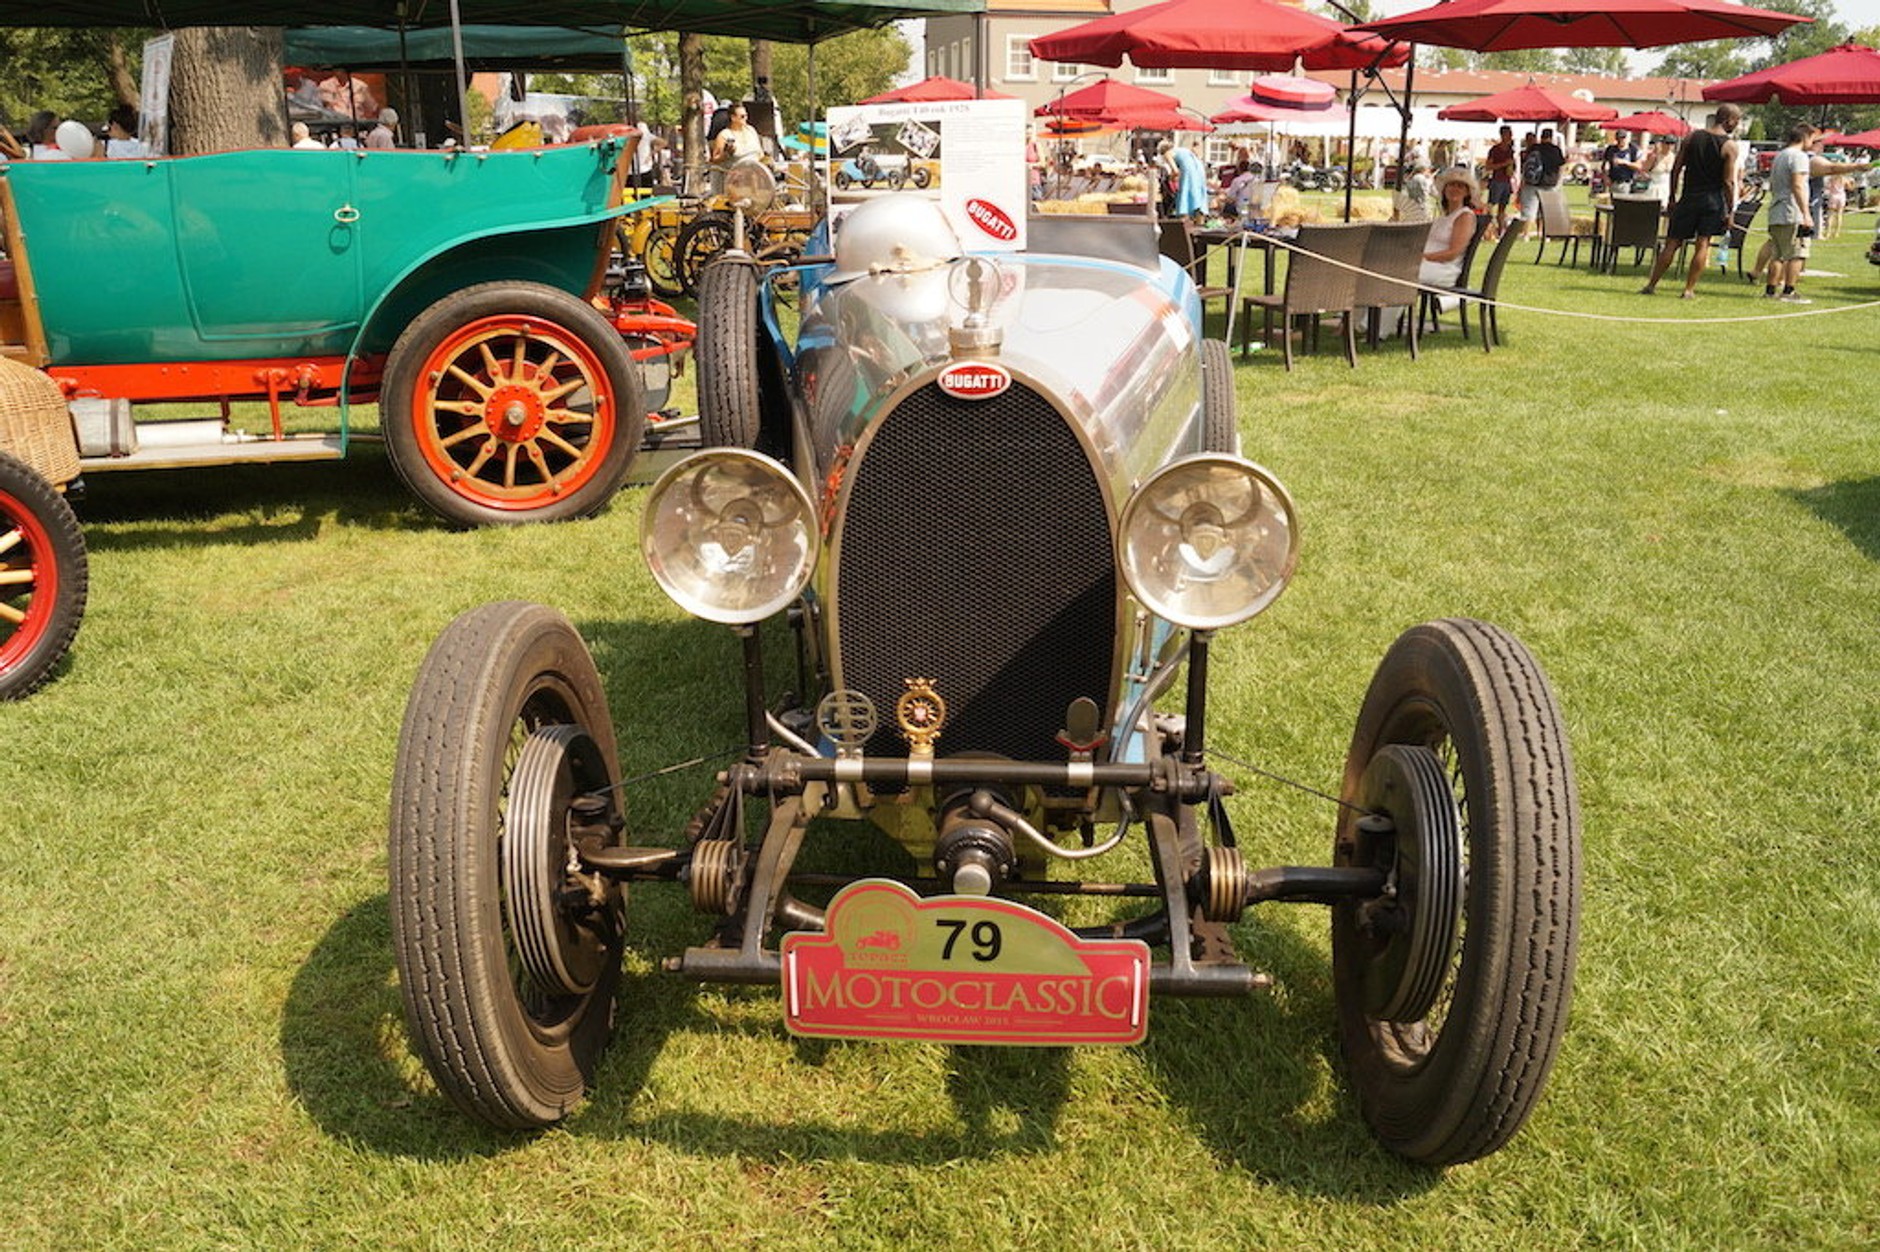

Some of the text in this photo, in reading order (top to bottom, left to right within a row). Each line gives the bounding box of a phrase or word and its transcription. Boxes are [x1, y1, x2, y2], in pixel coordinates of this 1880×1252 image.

[967, 201, 1013, 239] BUGATTI
[944, 374, 1003, 389] BUGATTI
[936, 919, 1003, 962] 79
[803, 967, 1130, 1019] MOTOCLASSIC
